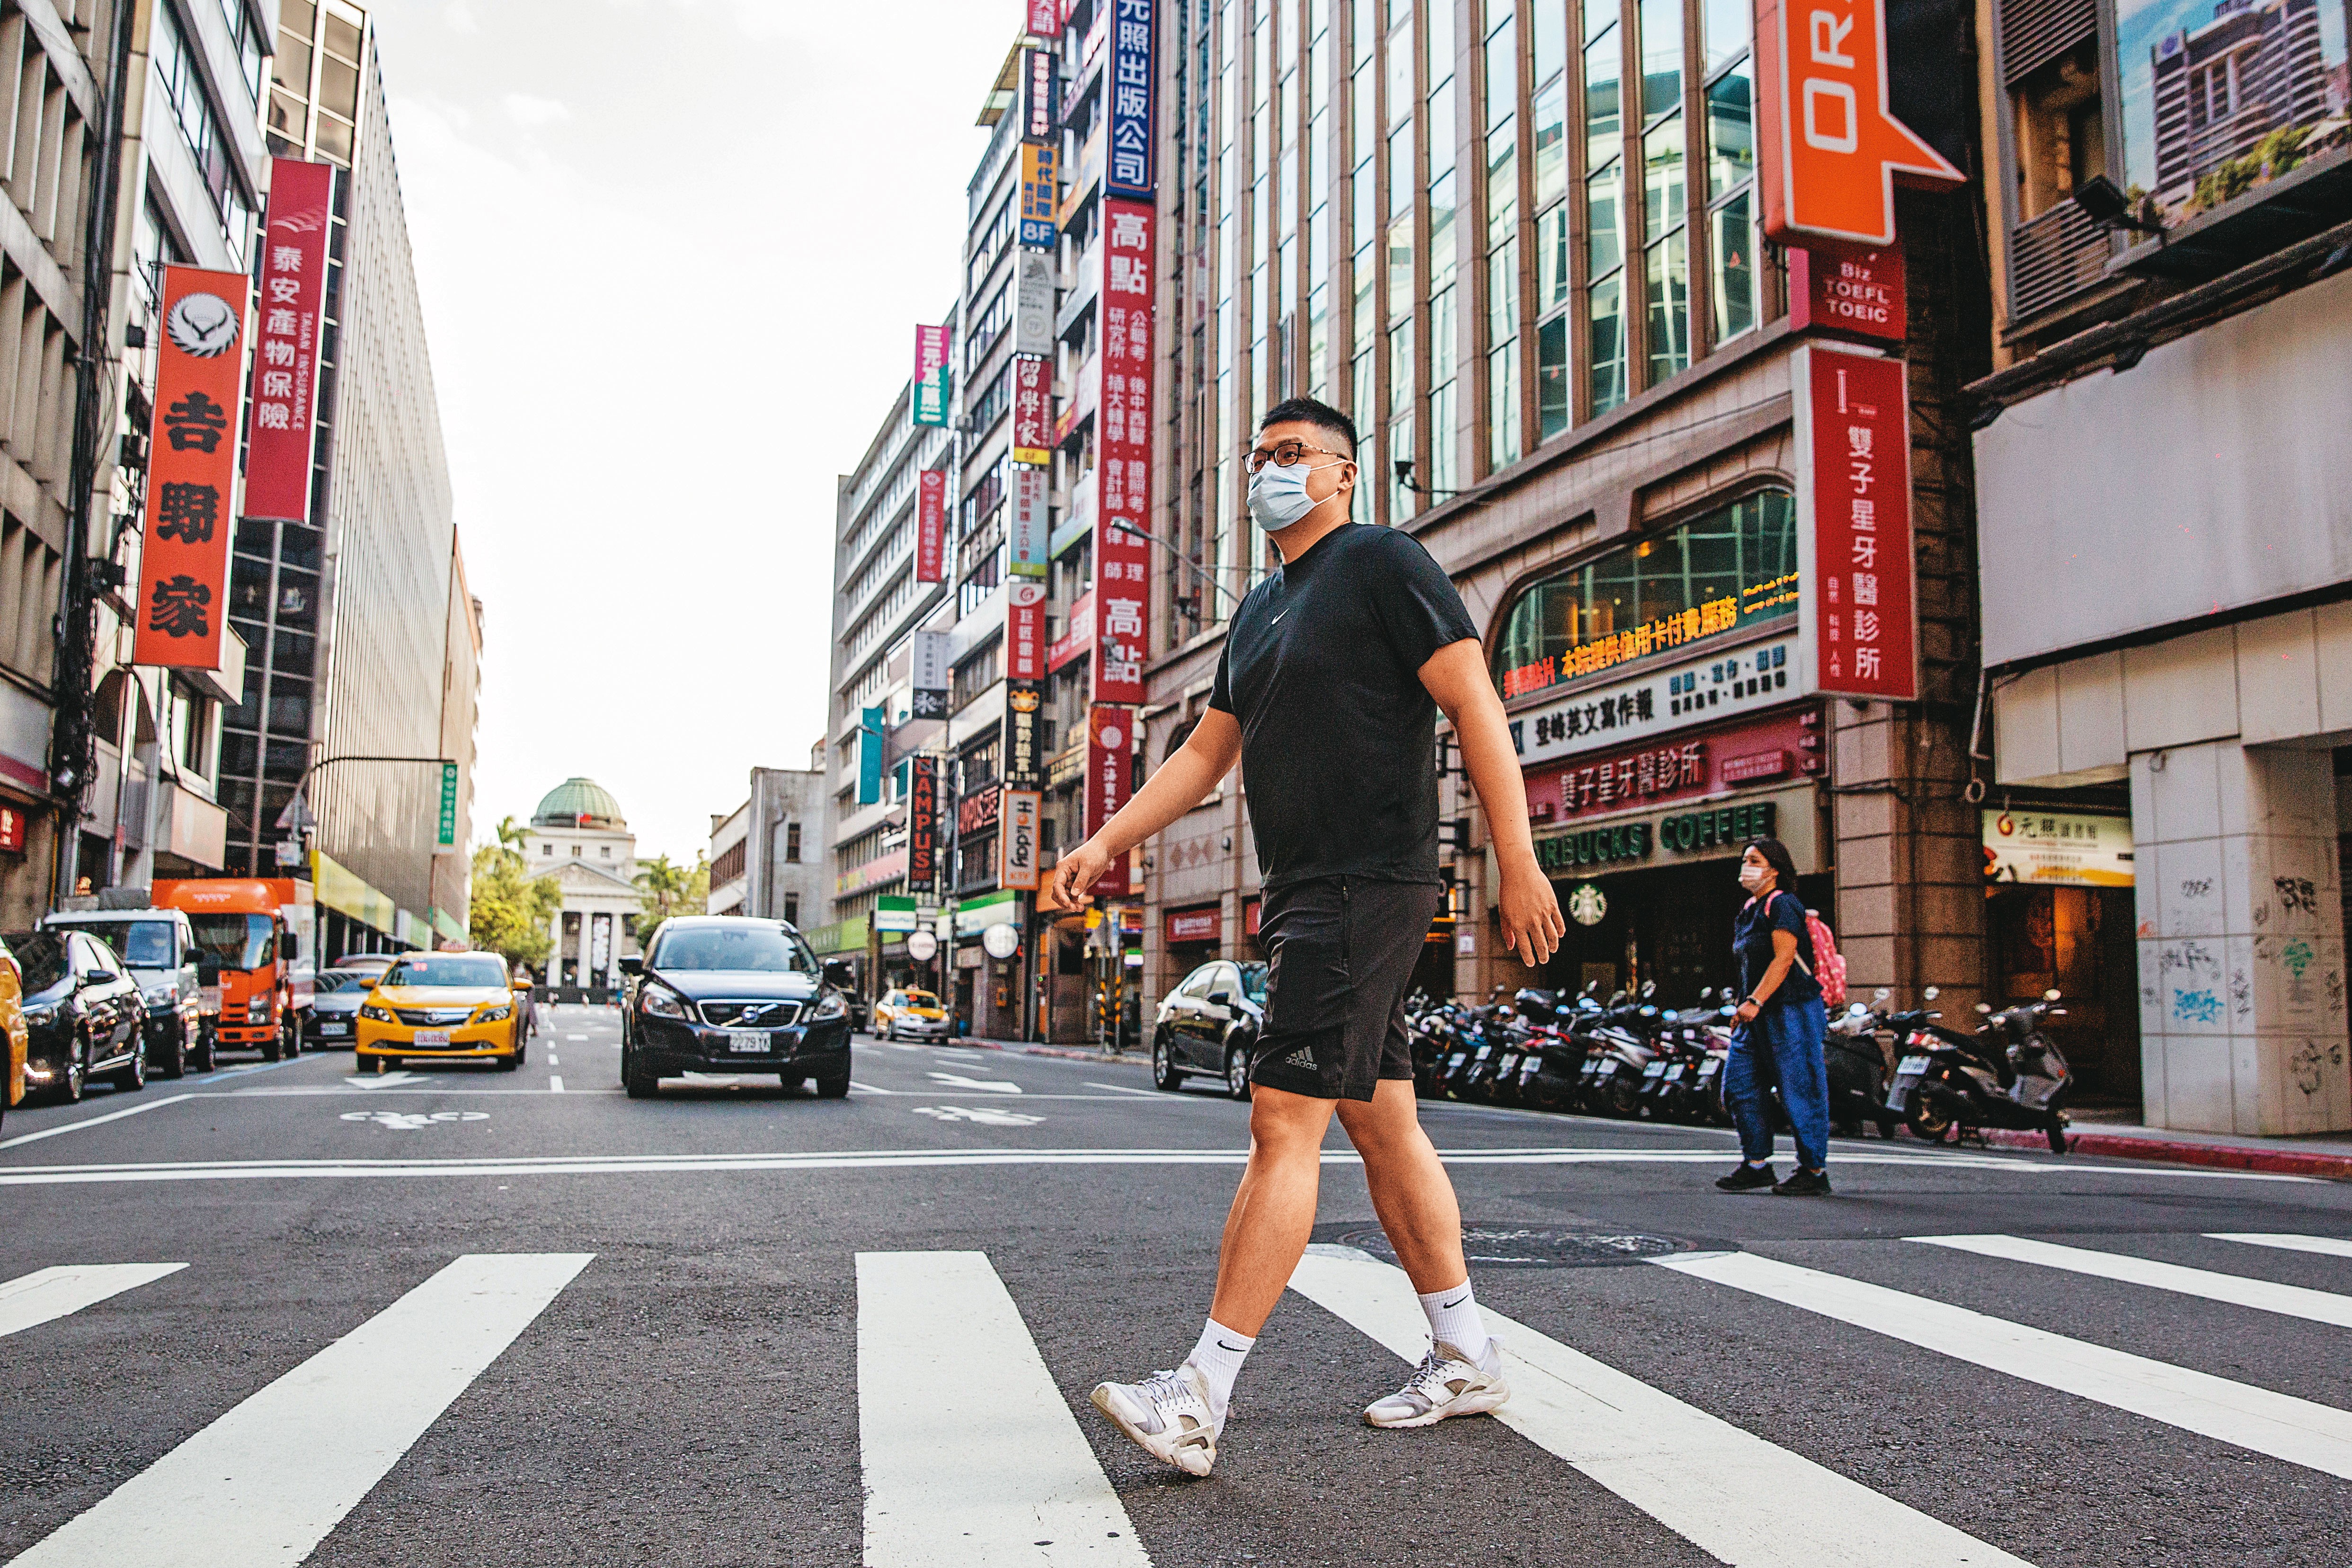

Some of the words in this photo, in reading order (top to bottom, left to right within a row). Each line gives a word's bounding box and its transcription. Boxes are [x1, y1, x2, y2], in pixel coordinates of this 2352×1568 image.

[1114, 0, 1150, 185] 元照出版公司
[1022, 221, 1052, 242] 8F
[1110, 213, 1148, 294] 高點
[1823, 278, 1890, 305] TOEFL
[1825, 297, 1889, 323] TOEIC
[258, 245, 303, 430] 泰安產物保險
[1017, 361, 1041, 446] 留學家
[1847, 426, 1881, 681] 雙子星牙醫診所
[1104, 597, 1142, 684] 高點
[1561, 741, 1702, 809] 雙子星牙醫診所
[914, 758, 932, 868] CAMPUS
[1011, 801, 1033, 867] Holiday
[1658, 804, 1768, 850] COFFEE
[1285, 1056, 1318, 1071] adidas
